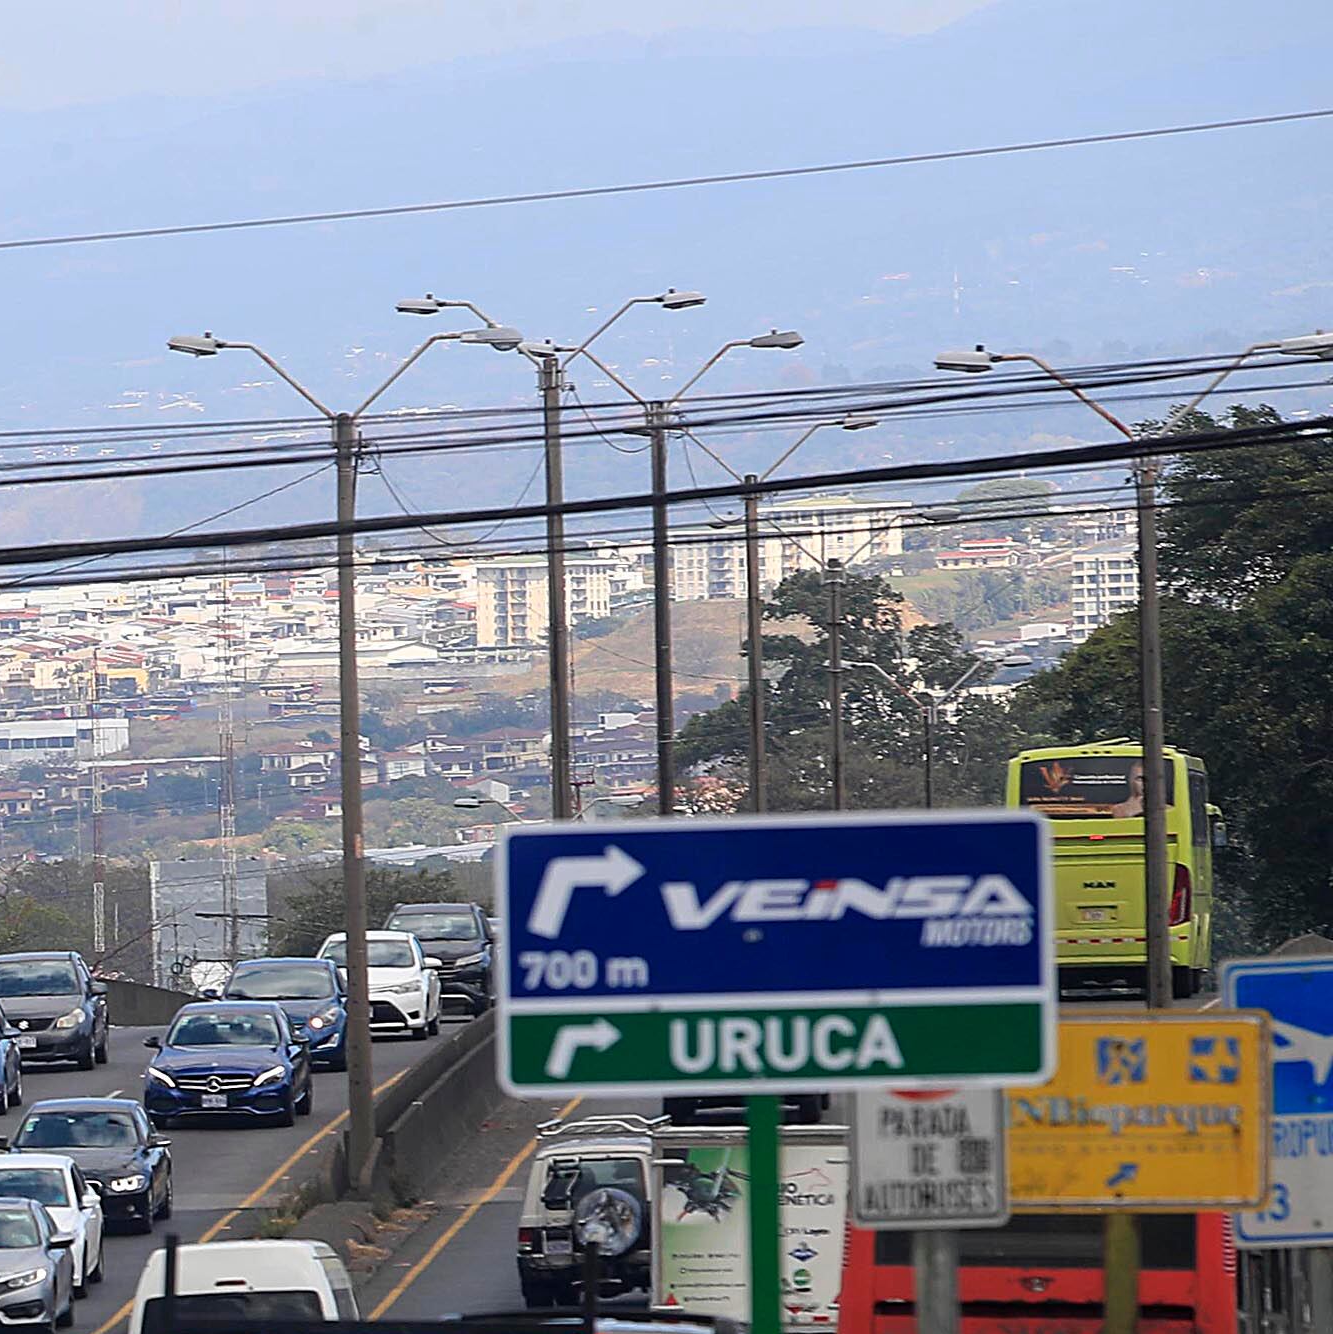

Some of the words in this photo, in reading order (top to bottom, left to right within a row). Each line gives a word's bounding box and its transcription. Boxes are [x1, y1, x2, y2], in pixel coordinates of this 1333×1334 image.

[919, 918, 1035, 949] MOTORS
[519, 951, 599, 990] 700
[605, 956, 650, 988] m
[668, 1014, 906, 1075] URUCA
[878, 1105, 972, 1138] PARADA
[910, 1143, 939, 1175] DE
